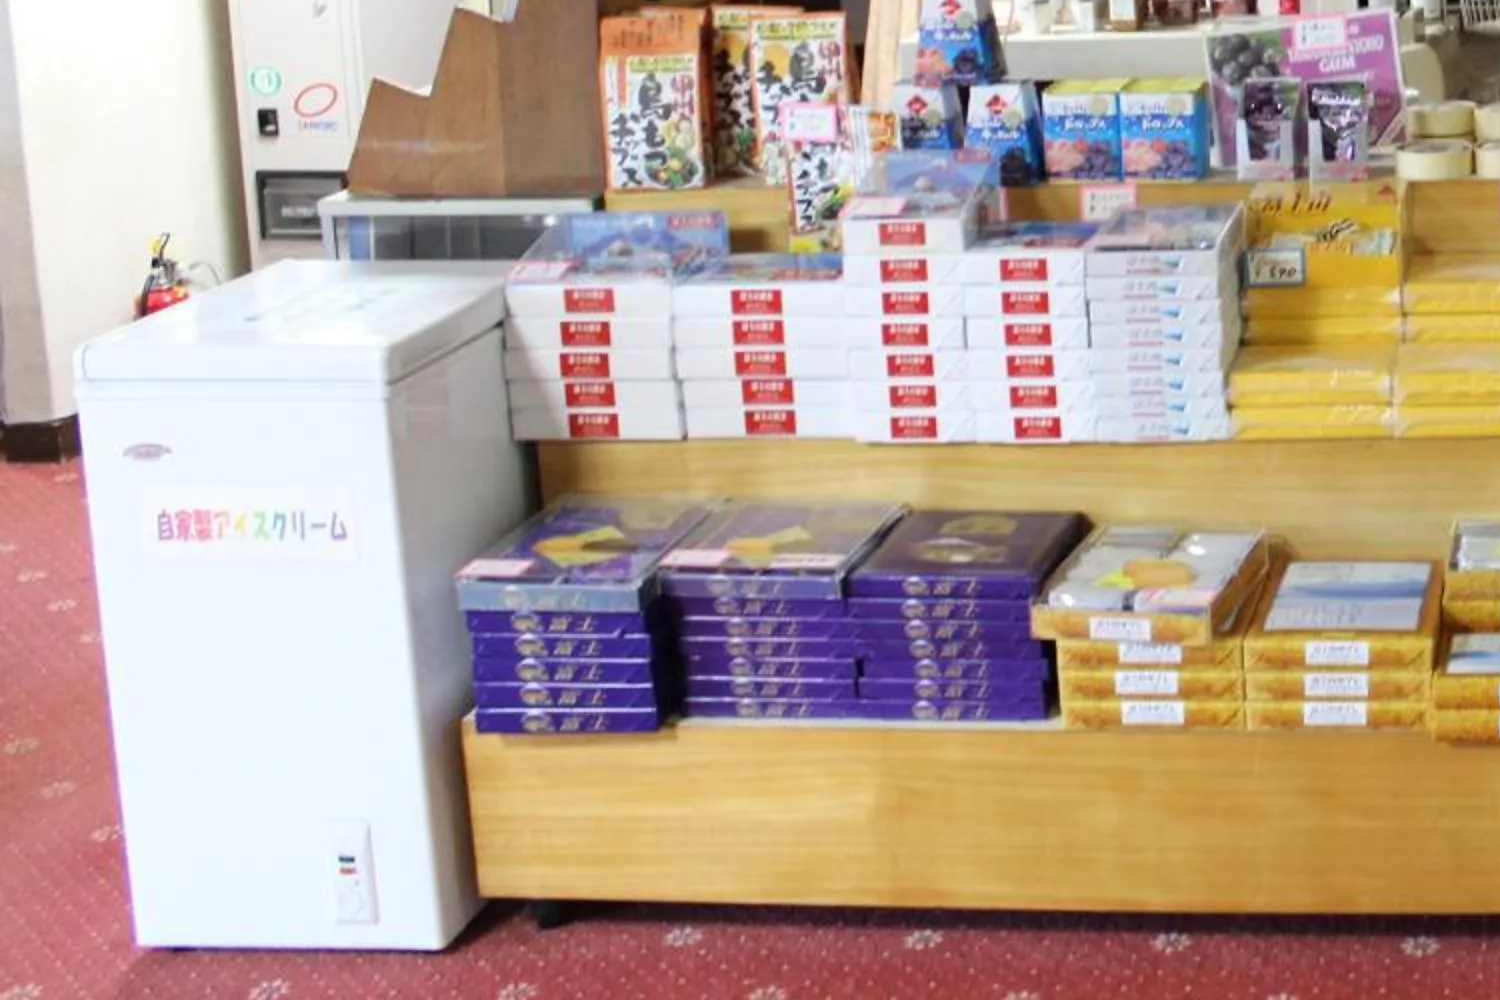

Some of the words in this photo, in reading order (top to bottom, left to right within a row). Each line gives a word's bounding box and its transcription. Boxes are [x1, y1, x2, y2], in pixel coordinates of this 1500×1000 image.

[157, 508, 347, 541] 自家製アイスクリーム
